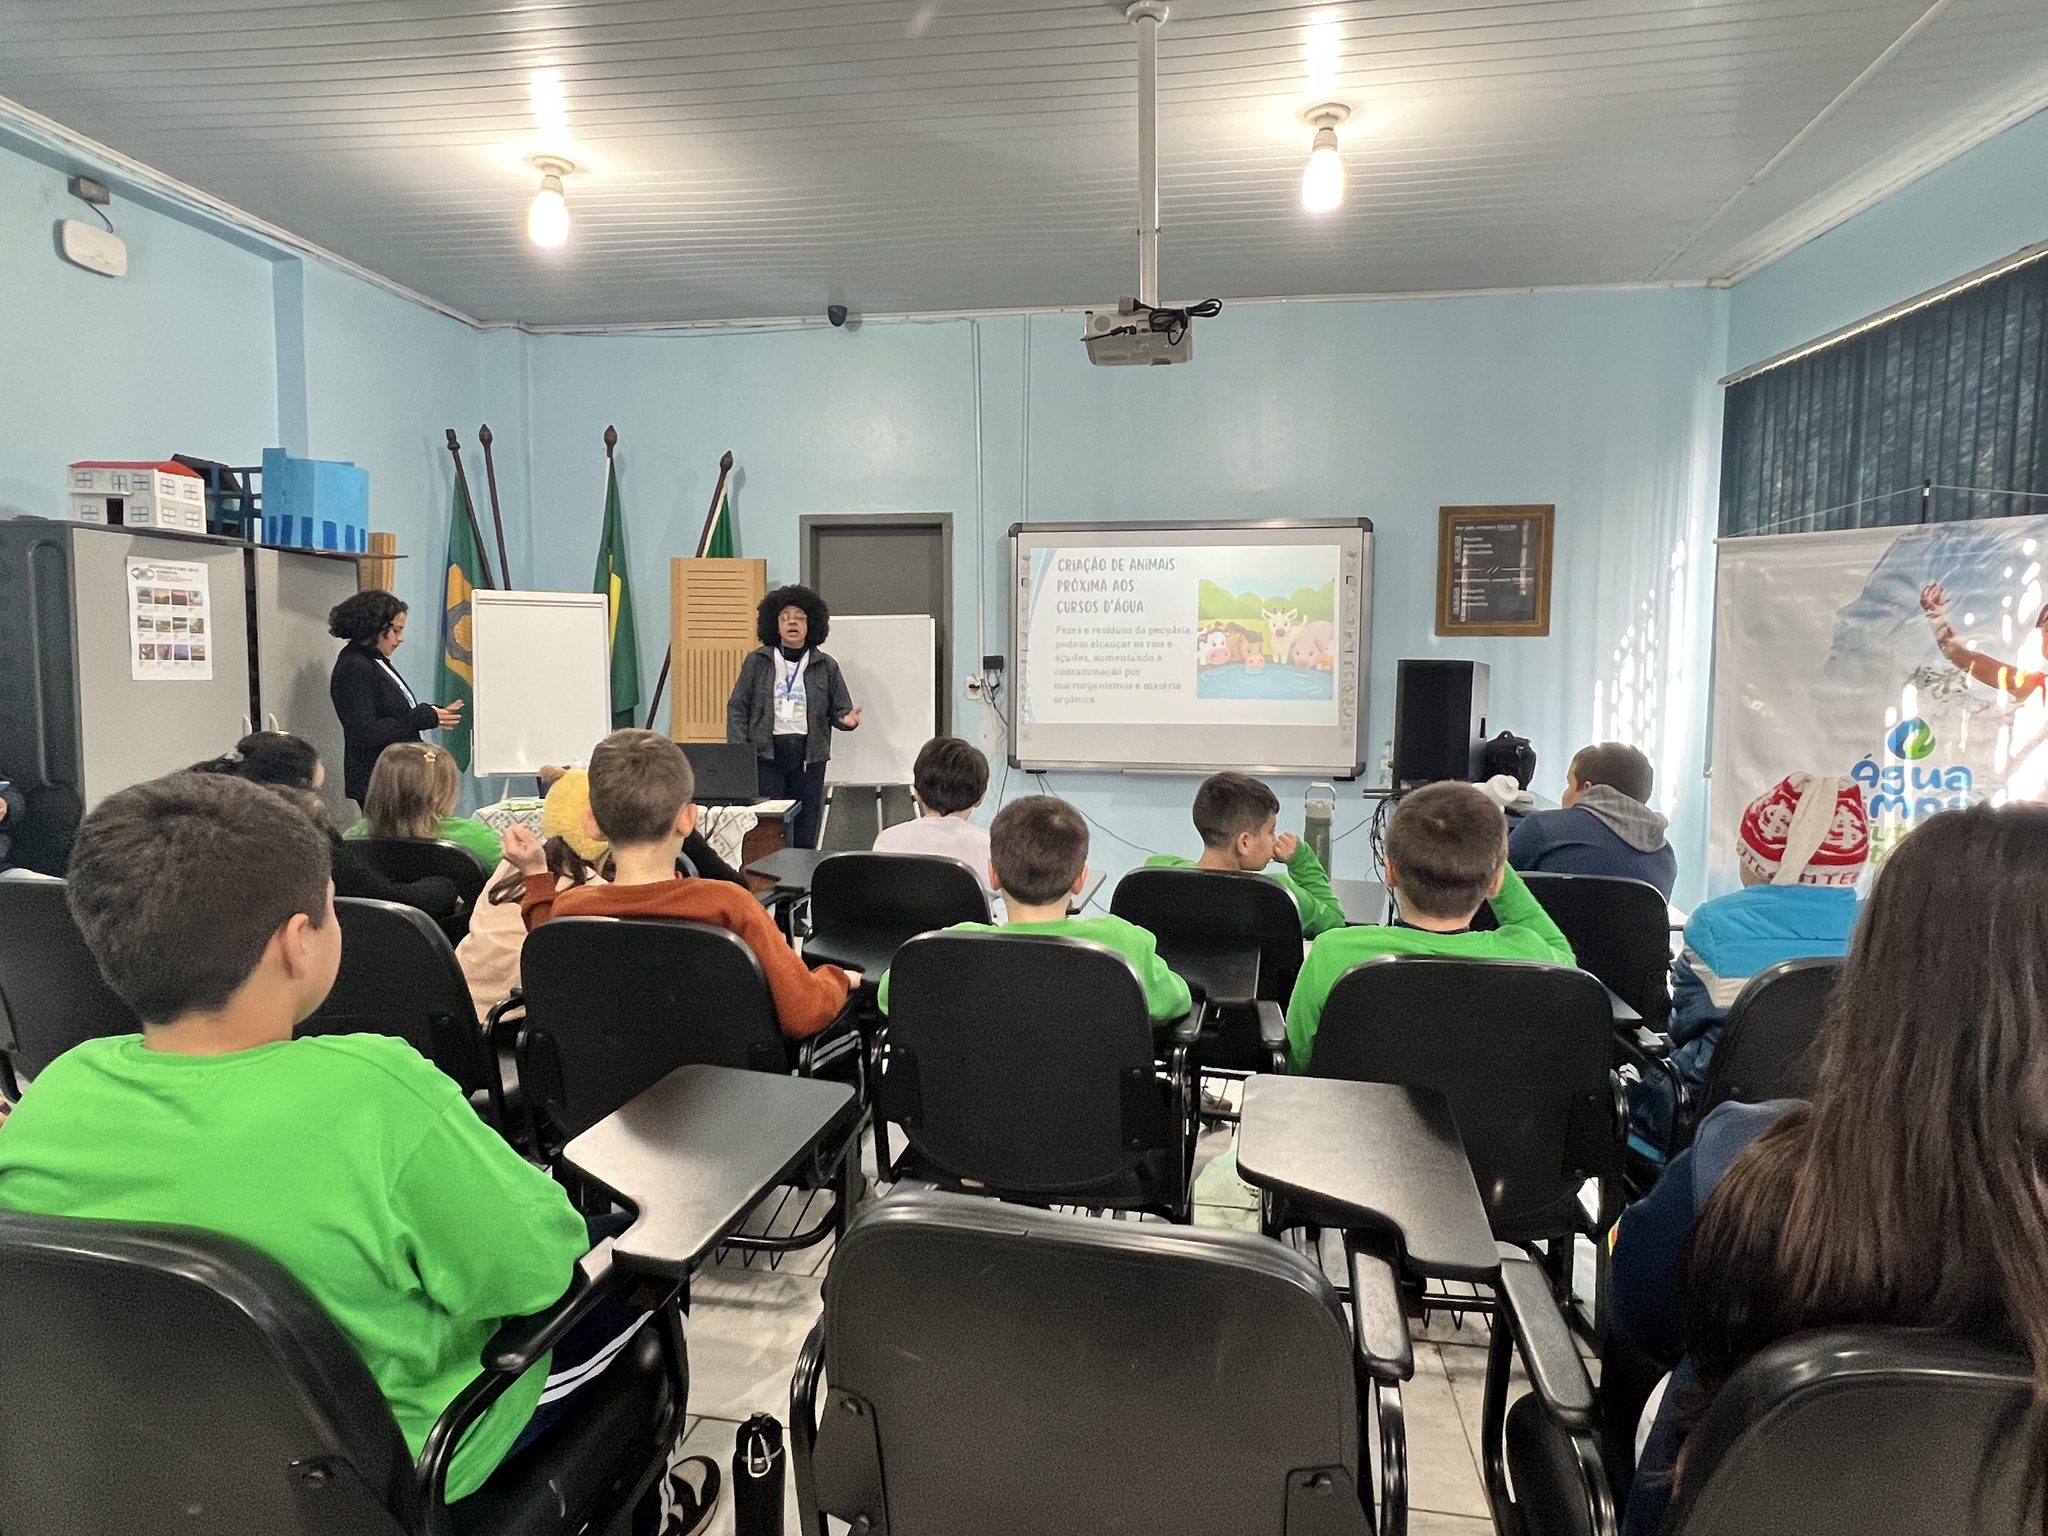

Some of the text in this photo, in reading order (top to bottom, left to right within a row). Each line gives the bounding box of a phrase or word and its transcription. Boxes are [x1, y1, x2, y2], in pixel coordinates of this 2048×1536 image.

[1058, 557, 1175, 574] CRIAÇÃO DE ANIMAIS
[1057, 577, 1135, 592] PRÓXIMA AOS
[1056, 597, 1144, 613] CURSOS D'ÁGUA
[1134, 625, 1146, 634] da
[1148, 625, 1191, 636] pecuária
[1055, 639, 1088, 650] podem
[1090, 639, 1131, 650] alcançar
[1146, 640, 1166, 648] rios
[1092, 653, 1155, 662] aumentando
[1054, 668, 1141, 677] contaminação por
[1143, 681, 1181, 690] matéria
[1053, 695, 1096, 705] orgânica
[1850, 752, 1973, 796] Água
